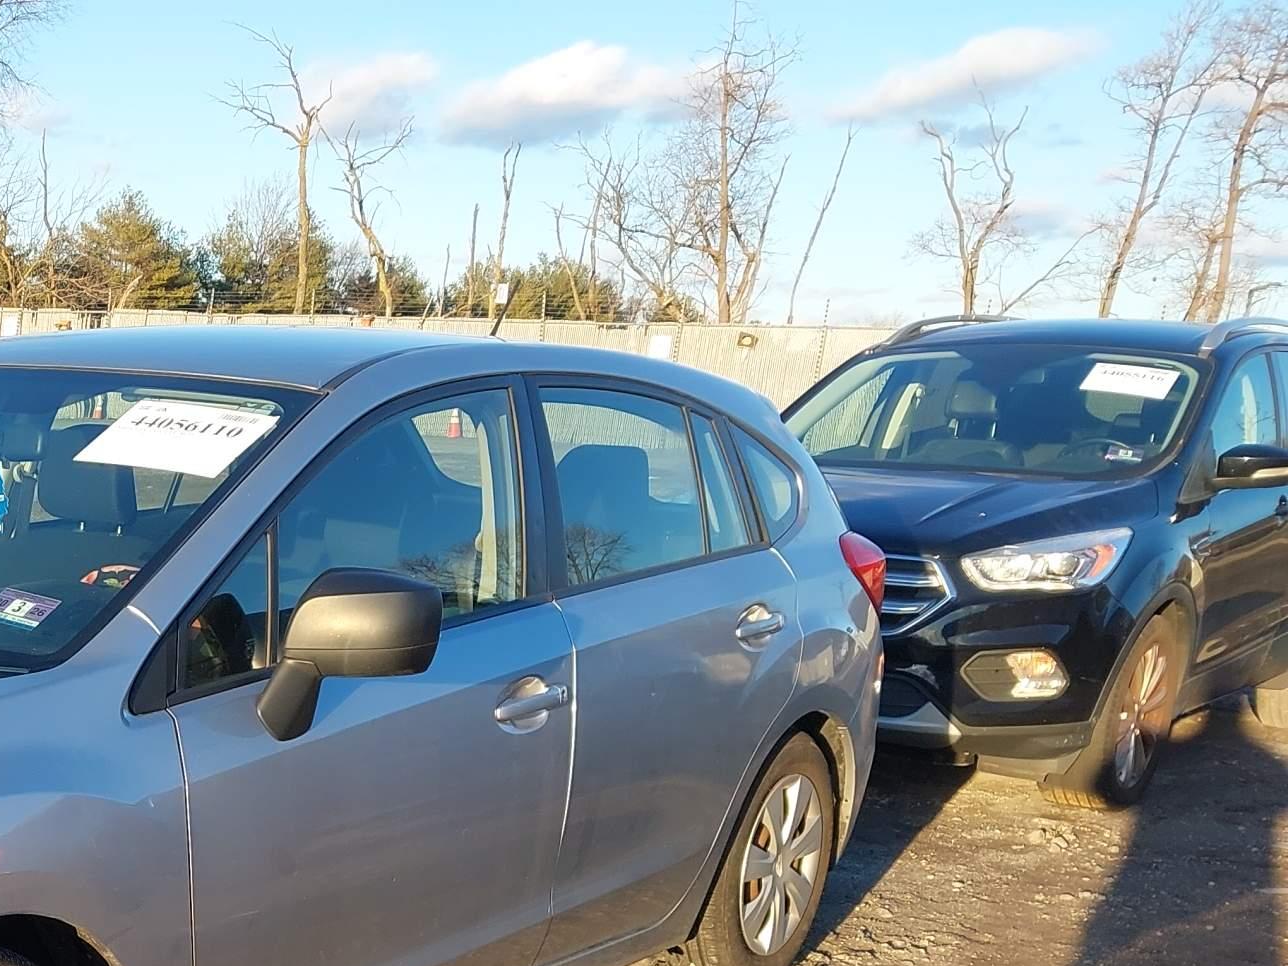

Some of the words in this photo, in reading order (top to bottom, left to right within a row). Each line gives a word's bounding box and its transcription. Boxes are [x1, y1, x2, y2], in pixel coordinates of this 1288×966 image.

[130, 415, 244, 438] 44056110
[11, 601, 25, 613] 3
[29, 607, 47, 617] 26
